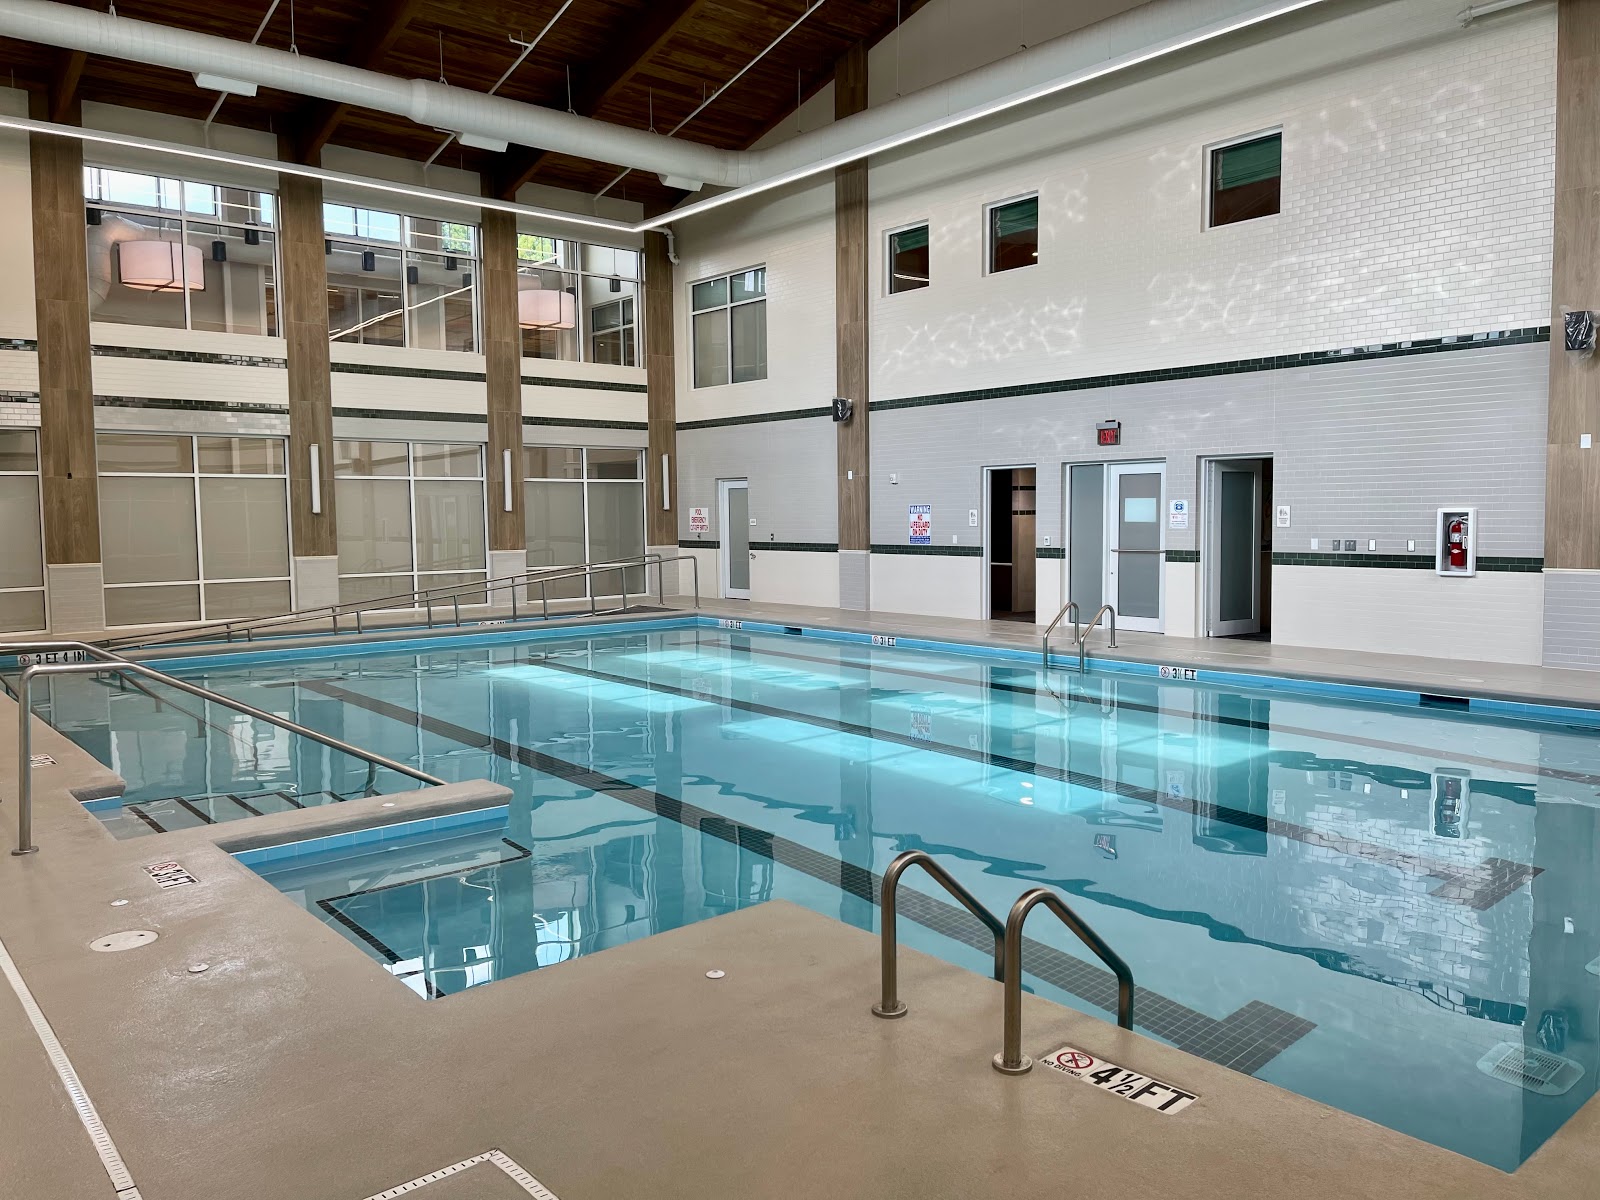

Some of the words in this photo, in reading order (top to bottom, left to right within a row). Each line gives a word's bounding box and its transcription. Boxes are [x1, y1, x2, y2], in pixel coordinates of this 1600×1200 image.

[1101, 430, 1116, 444] EXIT
[910, 505, 930, 514] WARNING
[1053, 1064, 1081, 1077] DIVING
[1128, 1081, 1197, 1111] FT
